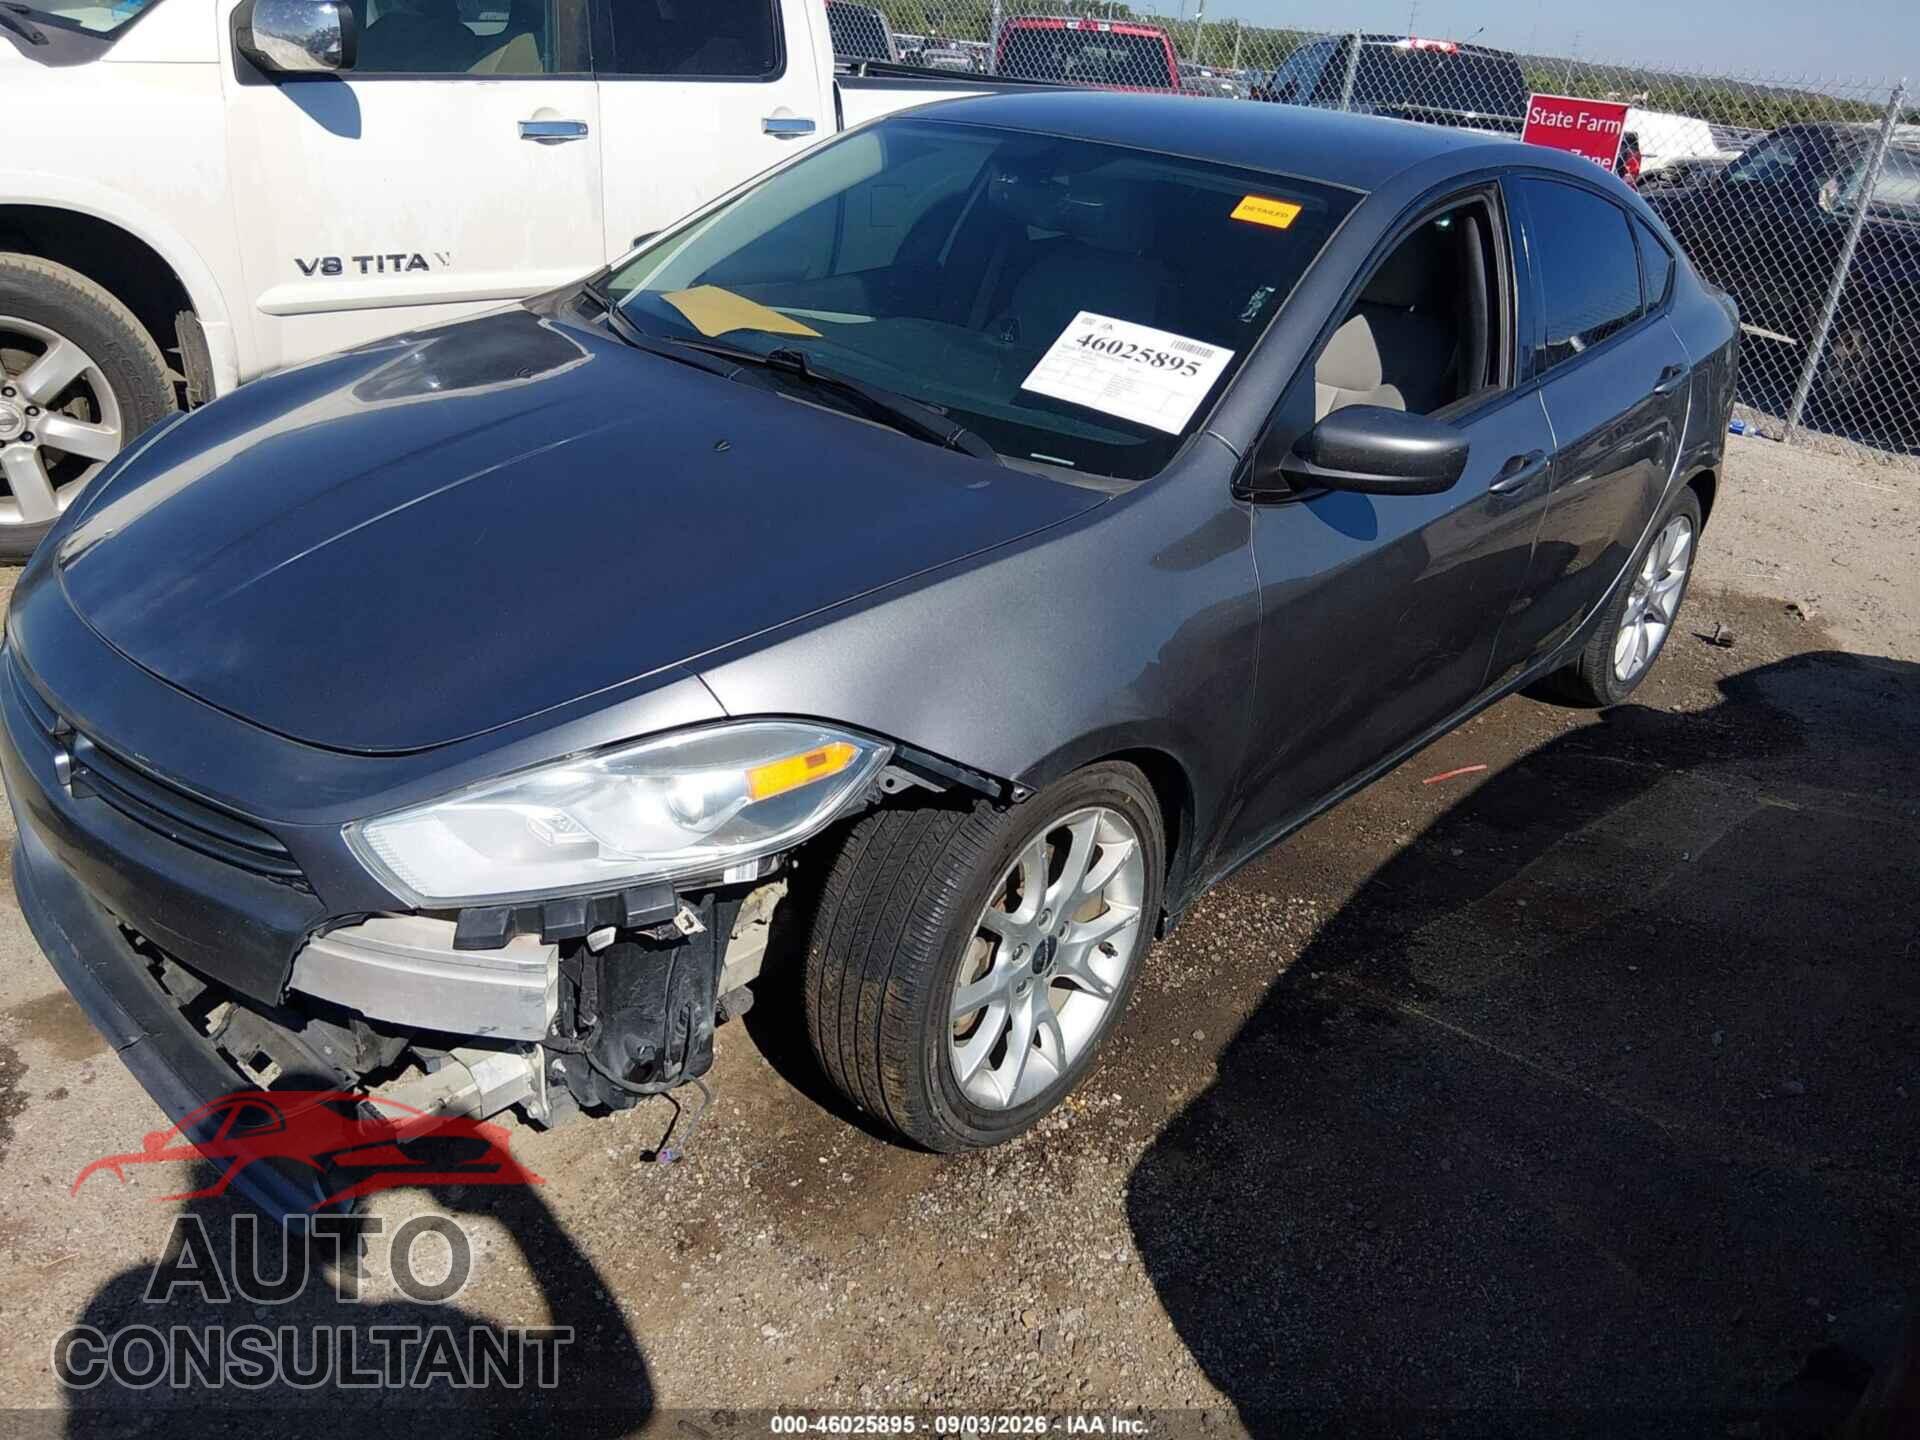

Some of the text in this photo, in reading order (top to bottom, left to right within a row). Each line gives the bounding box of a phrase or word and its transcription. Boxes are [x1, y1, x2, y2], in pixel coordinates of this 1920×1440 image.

[1529, 107, 1621, 135] State Farm
[294, 256, 343, 276] V8
[1076, 333, 1202, 377] 46025895
